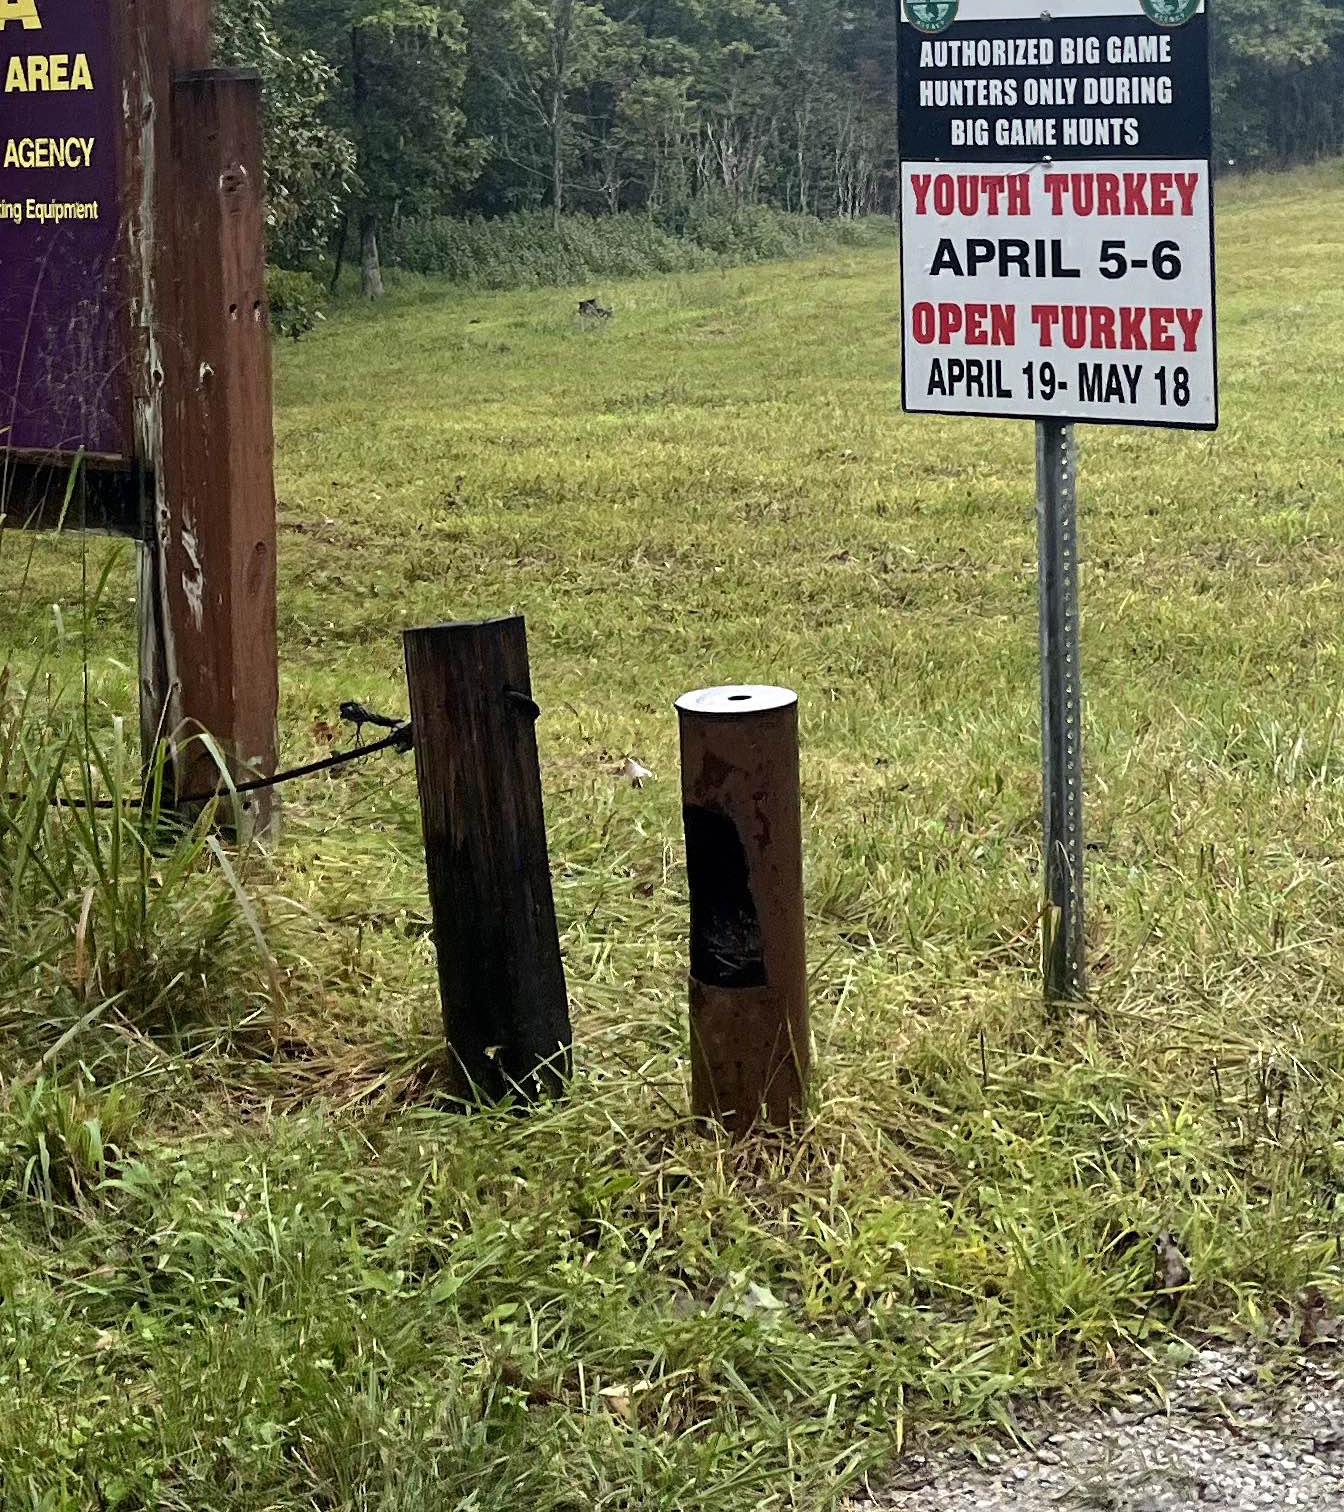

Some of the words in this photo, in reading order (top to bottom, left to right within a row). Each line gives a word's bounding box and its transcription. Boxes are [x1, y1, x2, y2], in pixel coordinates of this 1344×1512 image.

[920, 37, 1052, 67] AUTHORIZED
[1060, 37, 1100, 65] BIG
[1107, 35, 1171, 64] GAME
[5, 53, 93, 93] AREA
[920, 79, 1018, 108] HUNTERS
[1024, 79, 1077, 105] ONLY
[1084, 77, 1172, 104] DURING
[951, 119, 988, 145] BIG
[995, 118, 1057, 145] GAME
[1063, 118, 1139, 145] HUNTS
[3, 138, 94, 168] AGENCY
[25, 201, 98, 222] Equipment
[910, 173, 1031, 216] YOUTH
[1045, 173, 1199, 216] TURKEY
[930, 239, 1081, 278] APRIL
[1099, 240, 1182, 280] 5-6
[912, 302, 1016, 347] OPEN
[1032, 304, 1203, 352] TURKEY
[927, 358, 1012, 399] APRIL
[1022, 361, 1068, 399] 19-
[1078, 363, 1143, 404] MAY
[1155, 366, 1191, 406] 18
